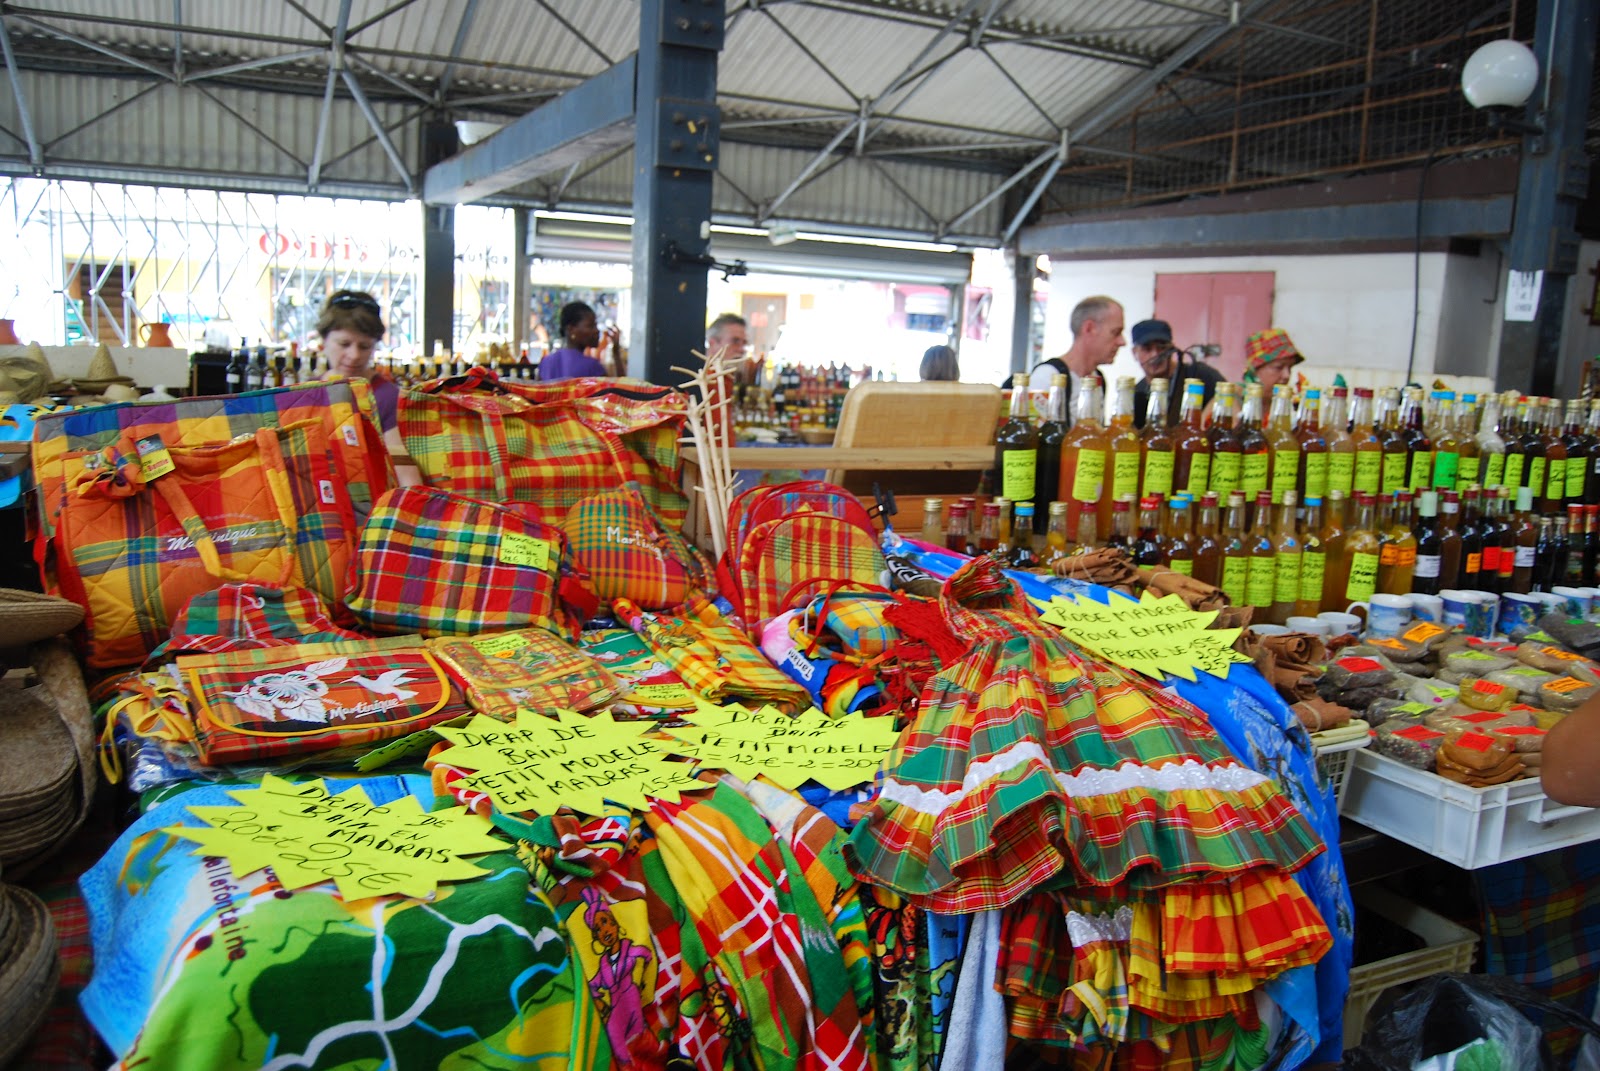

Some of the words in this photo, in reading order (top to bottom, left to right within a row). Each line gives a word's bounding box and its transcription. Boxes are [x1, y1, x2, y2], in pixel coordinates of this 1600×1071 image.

[167, 527, 256, 552] Mainique
[1053, 606, 1111, 622] ROBE
[1113, 603, 1190, 622] MADRAS
[1070, 627, 1126, 642] POUR
[1130, 618, 1198, 637] ENFANT
[1101, 646, 1168, 660] PARTIR
[715, 710, 801, 728] DRAP
[813, 720, 850, 729] DE
[456, 729, 534, 748] DRAP
[548, 724, 596, 742] DE
[701, 732, 784, 753] PETIT
[787, 743, 891, 754] MODELE
[764, 726, 827, 740] BAIN
[463, 764, 545, 790] PETIT
[560, 741, 661, 774] MODELE
[498, 744, 567, 766] BAIN
[496, 789, 538, 805] EN
[546, 763, 650, 796] MADRAS
[266, 786, 391, 817] DRAP
[404, 814, 454, 829] DE
[279, 802, 379, 830] BAIN
[390, 829, 430, 842] EN
[326, 829, 452, 864] MADRAS
[202, 857, 248, 961] ellefontaine
